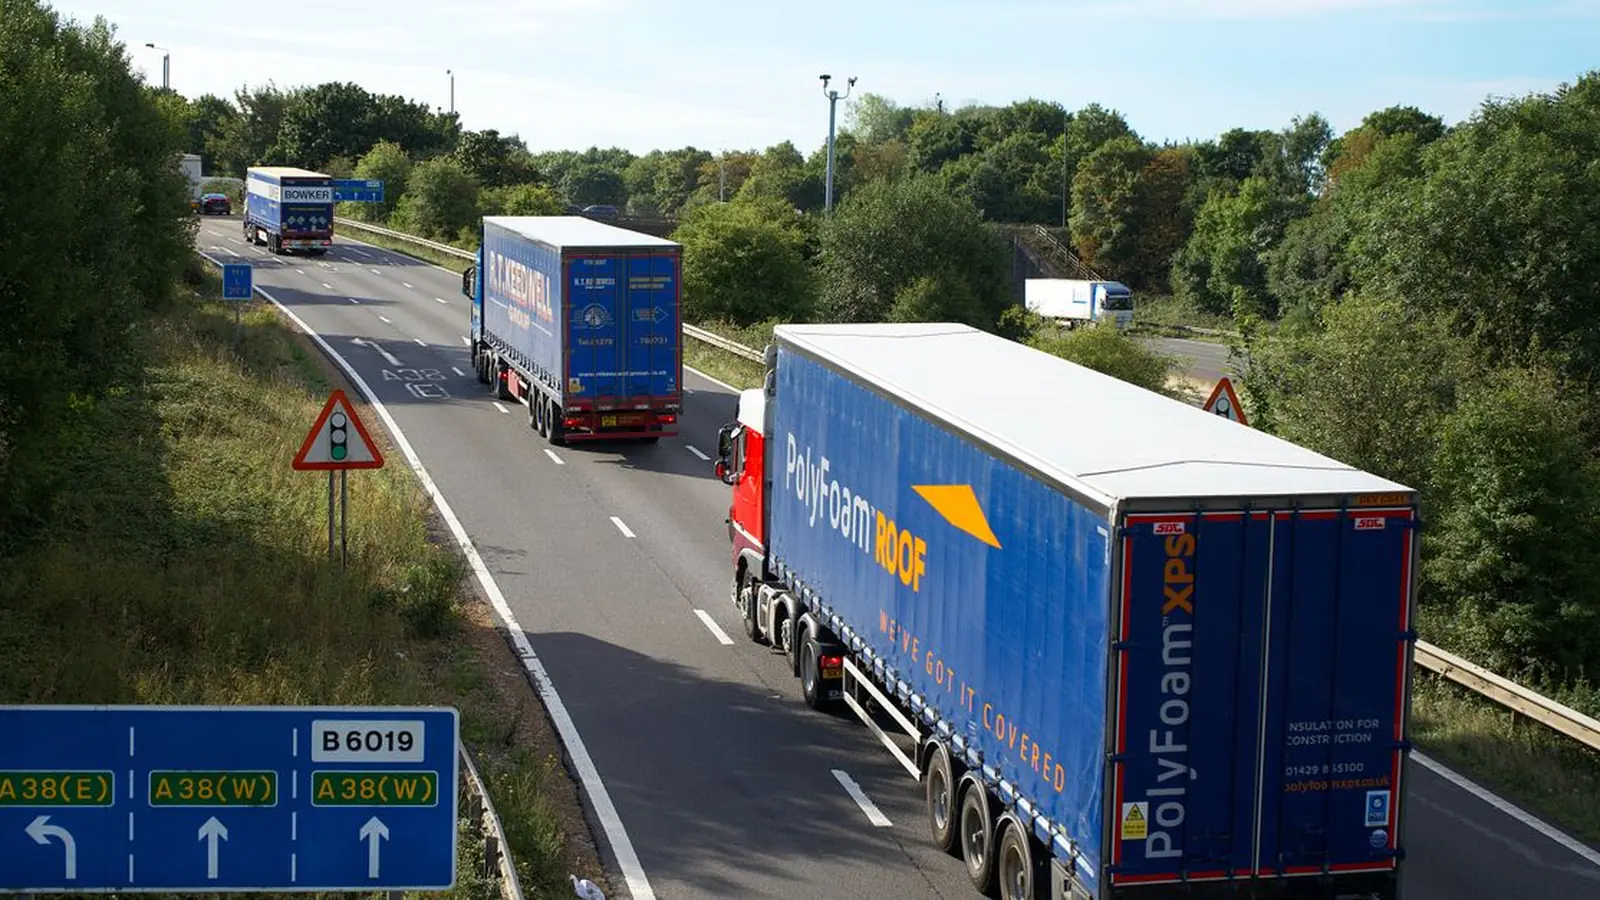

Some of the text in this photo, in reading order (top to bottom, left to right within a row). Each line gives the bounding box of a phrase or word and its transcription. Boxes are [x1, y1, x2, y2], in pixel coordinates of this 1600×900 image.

[284, 190, 329, 199] BOWKER
[381, 368, 447, 381] A38
[786, 432, 927, 593] PolyFoam ROOF
[880, 609, 1065, 793] WE'VE GOT IT COVERED
[1145, 532, 1197, 858] PolyFoam XPS
[1289, 719, 1379, 732] NSULATON FOR
[322, 731, 414, 752] B 6019
[1285, 764, 1318, 776] 01429
